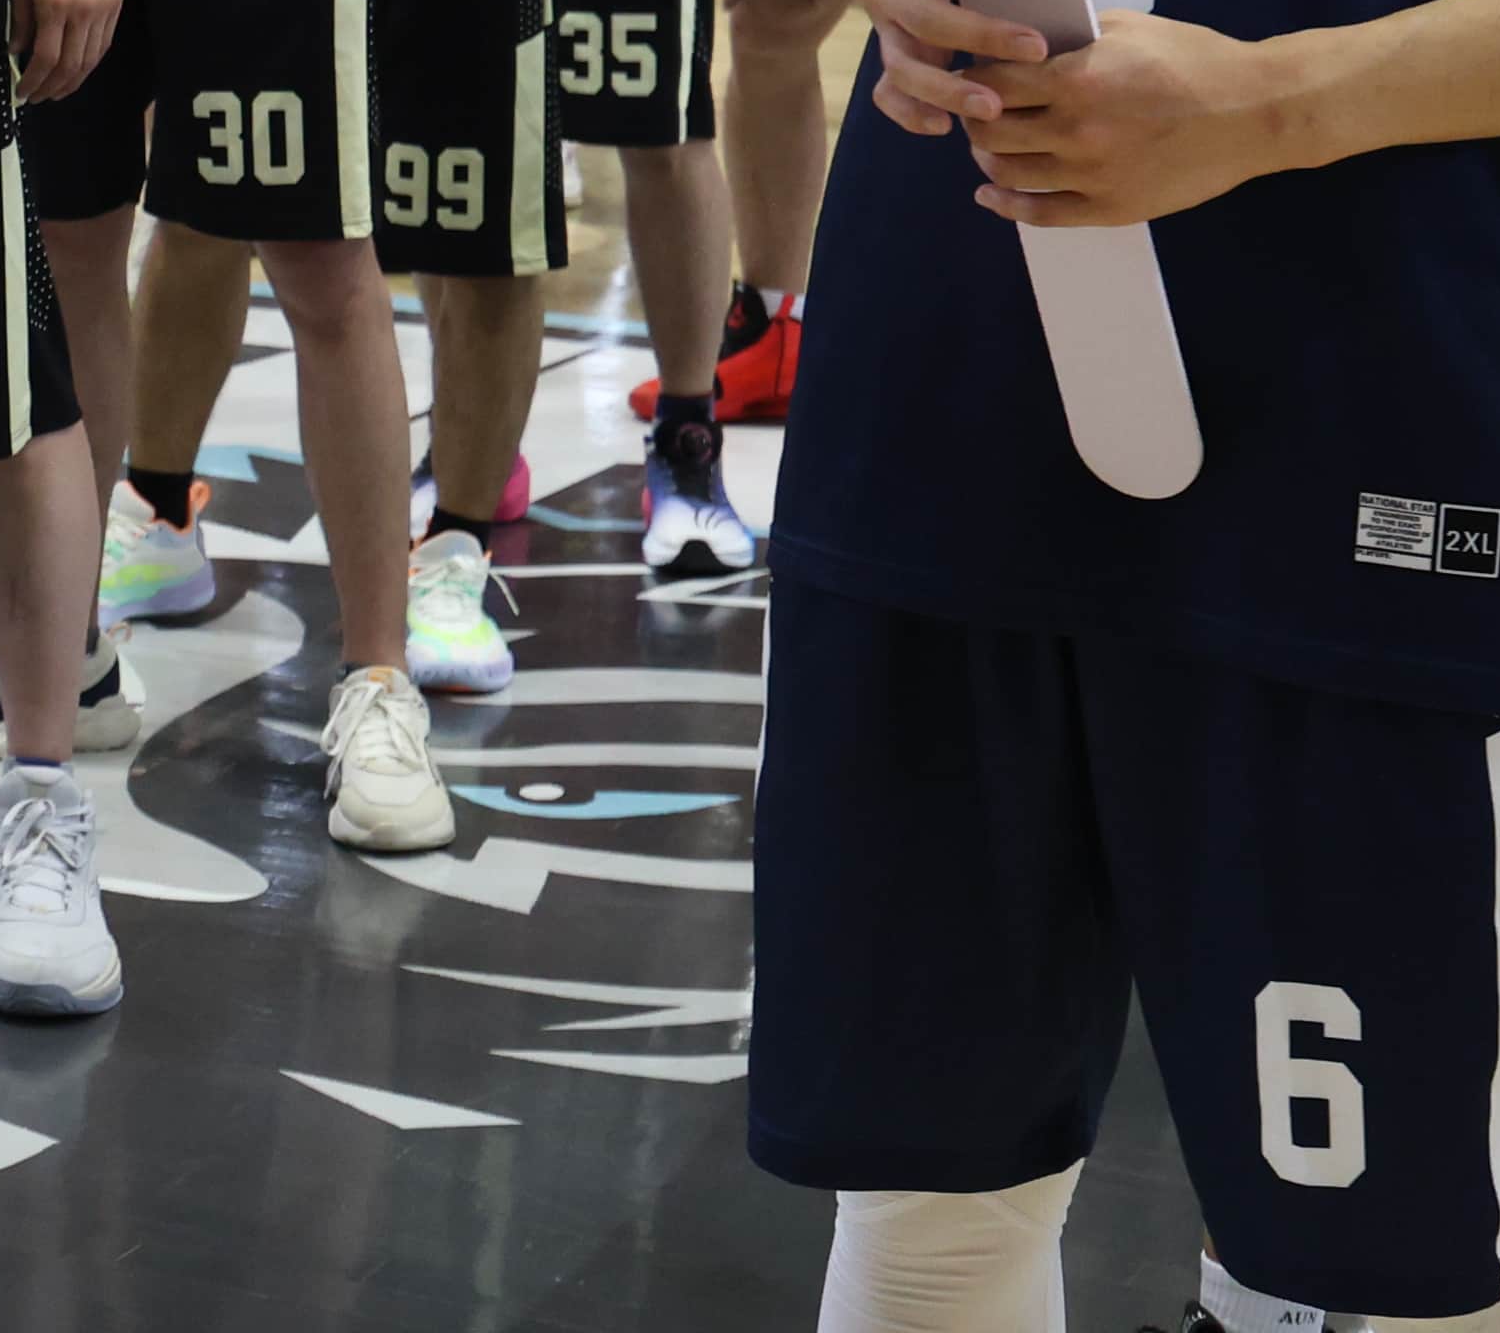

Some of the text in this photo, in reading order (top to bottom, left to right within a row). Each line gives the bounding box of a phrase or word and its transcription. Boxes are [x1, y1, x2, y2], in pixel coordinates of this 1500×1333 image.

[559, 13, 658, 98] 35
[193, 90, 304, 186] 30
[384, 143, 485, 229] 99
[1445, 530, 1495, 555] 2XL
[1255, 981, 1365, 1188] 6
